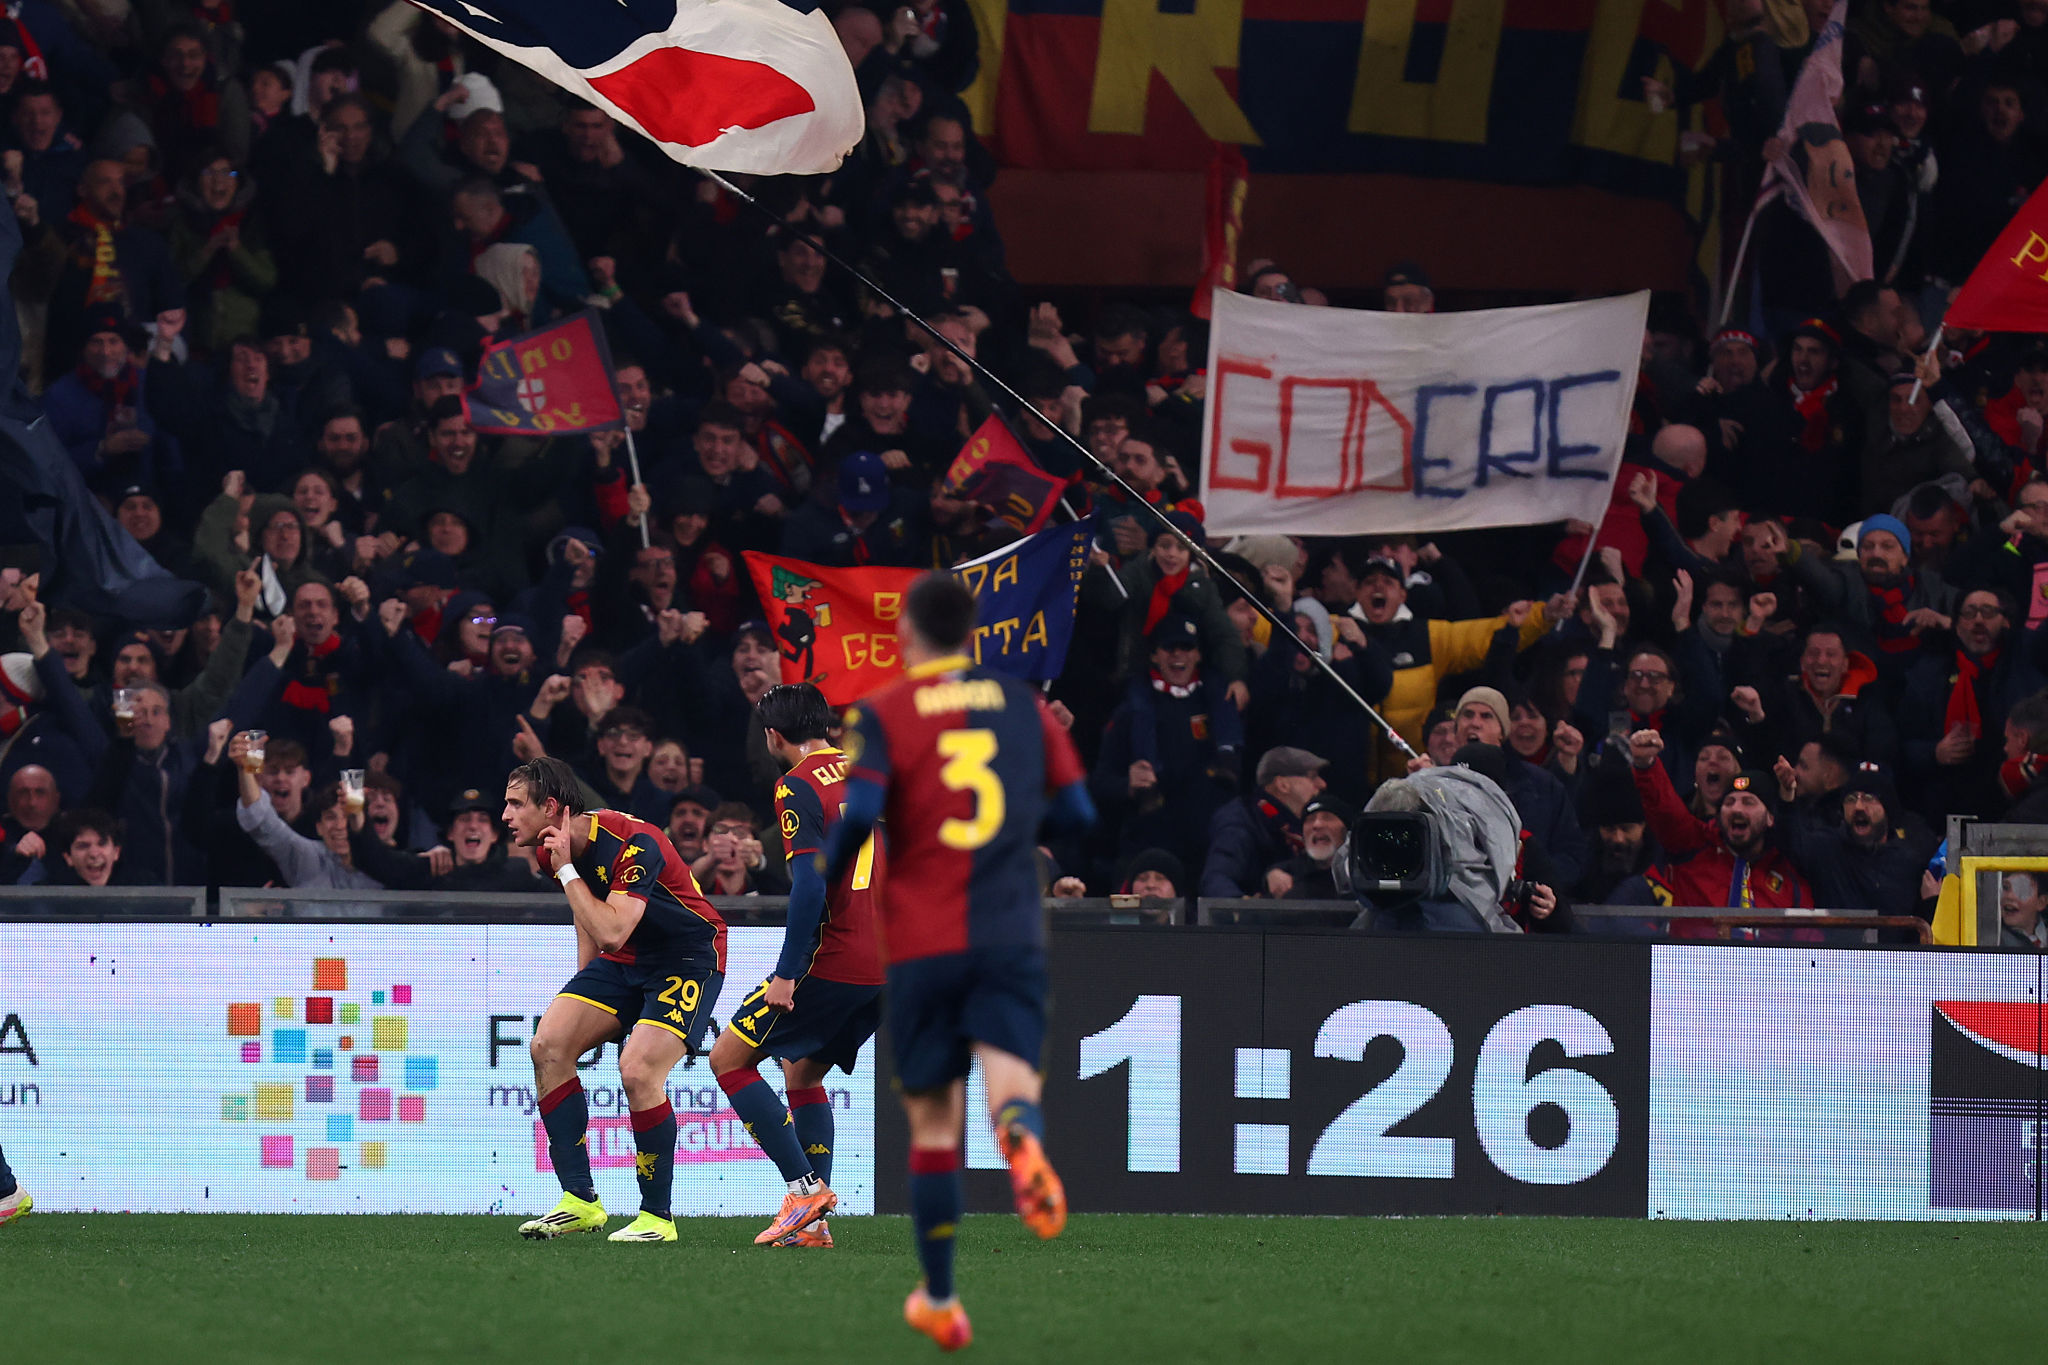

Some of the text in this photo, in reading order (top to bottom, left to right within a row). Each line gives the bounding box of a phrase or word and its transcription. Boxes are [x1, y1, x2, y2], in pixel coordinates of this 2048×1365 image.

[1208, 359, 1621, 498] GODERE
[936, 727, 1006, 850] 3
[657, 975, 700, 1012] 29
